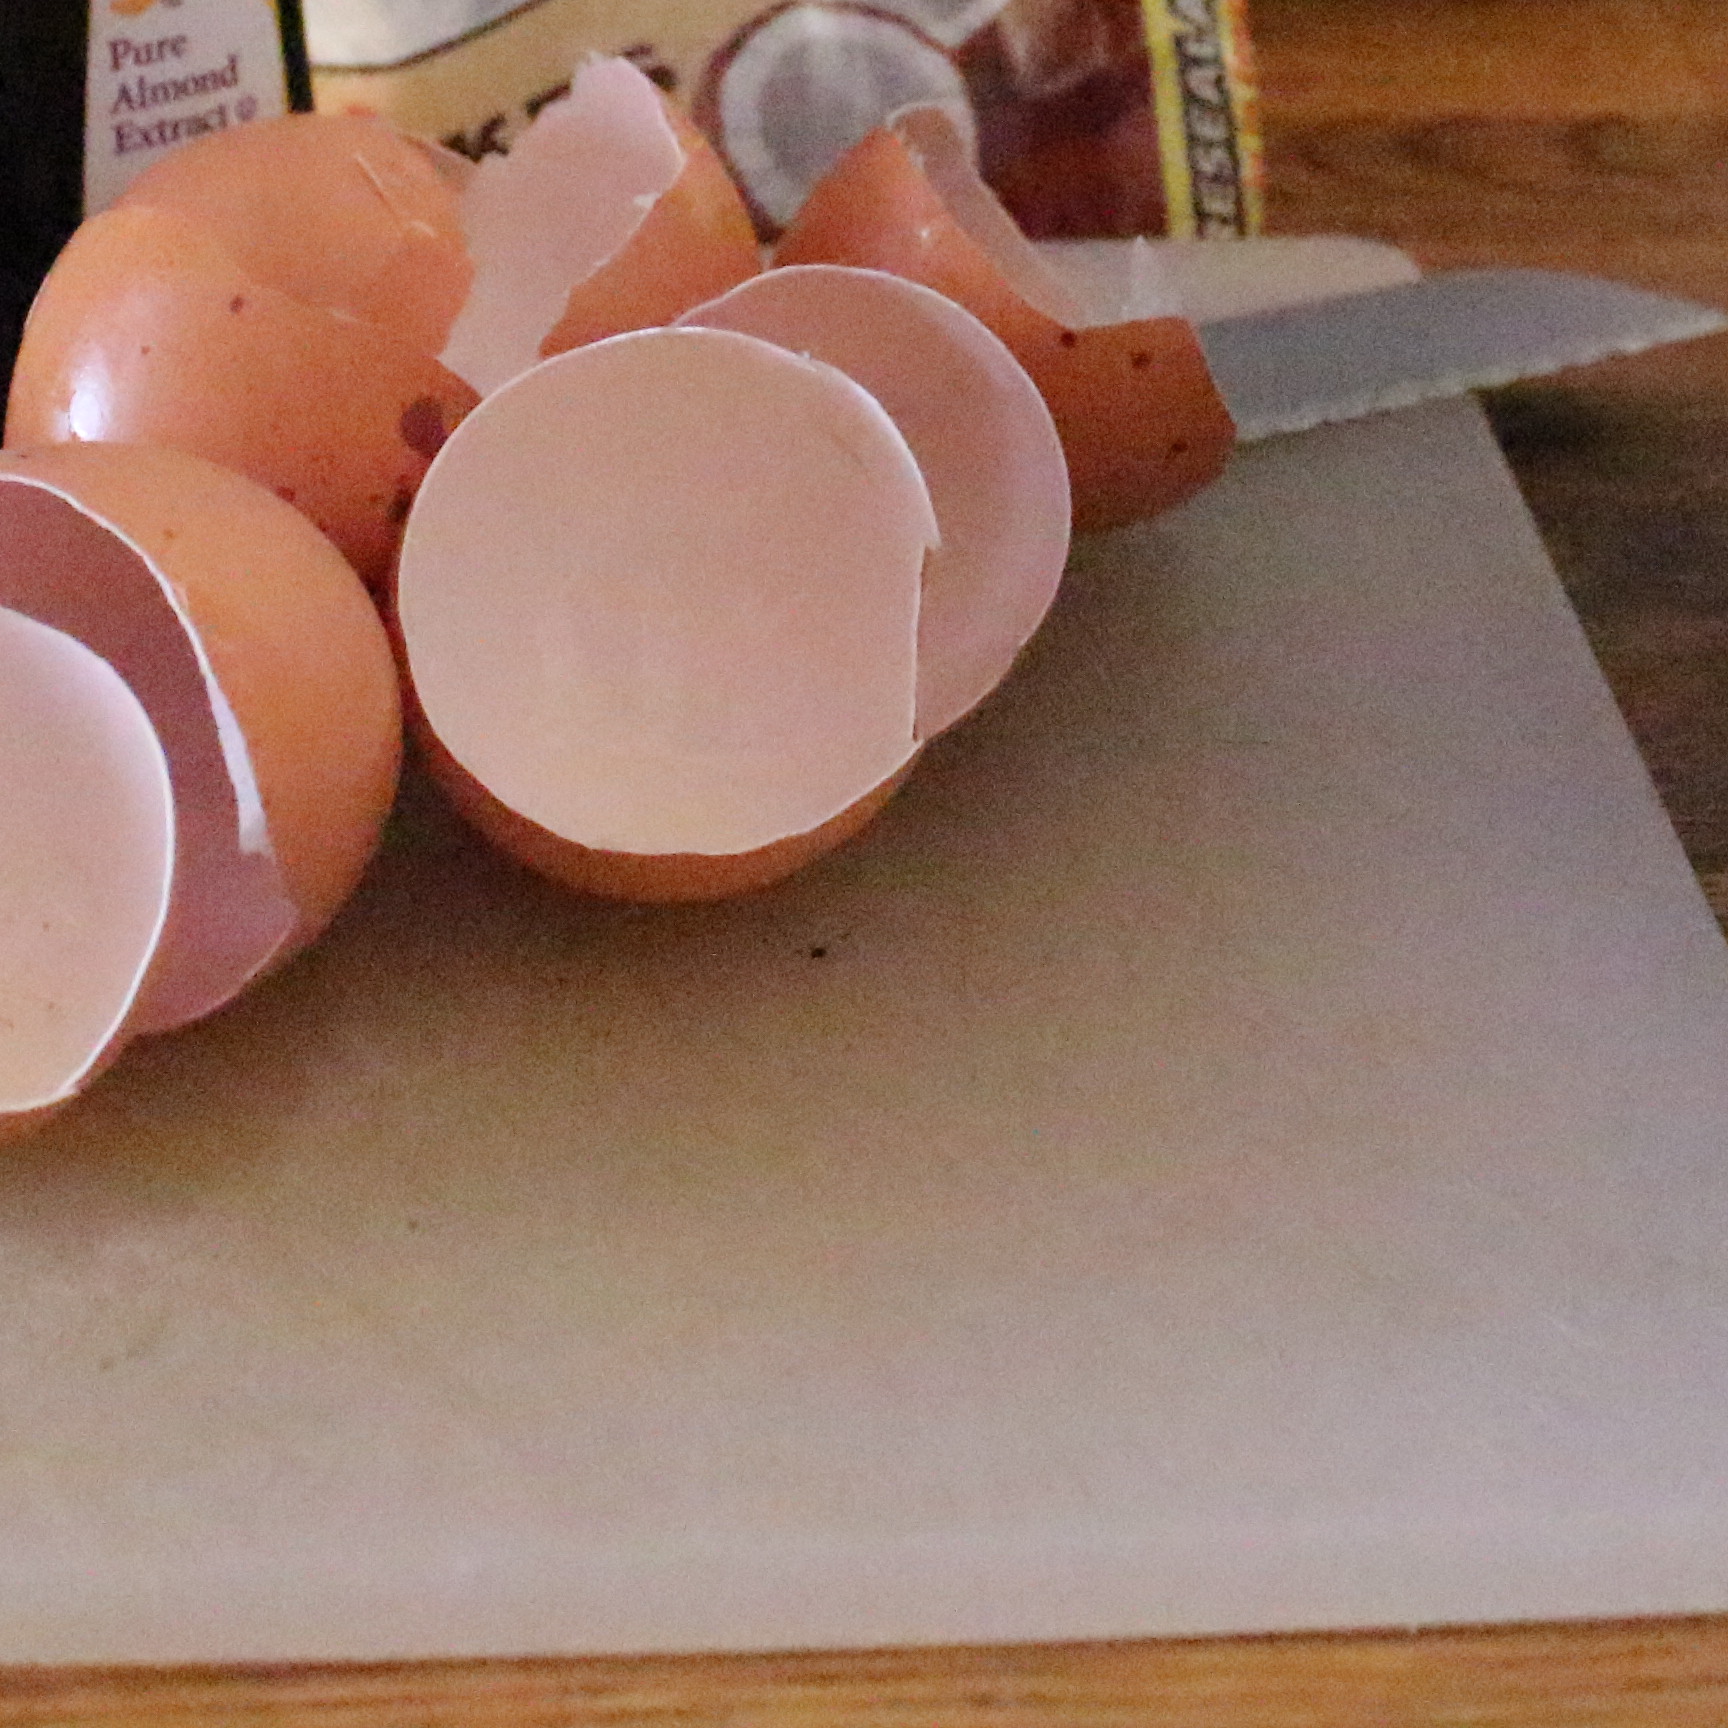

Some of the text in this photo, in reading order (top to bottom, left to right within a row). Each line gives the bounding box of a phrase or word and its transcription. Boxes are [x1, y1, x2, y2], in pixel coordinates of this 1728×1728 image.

[108, 34, 187, 72] Pure
[110, 54, 239, 116] Almond
[113, 104, 229, 156] Extract
